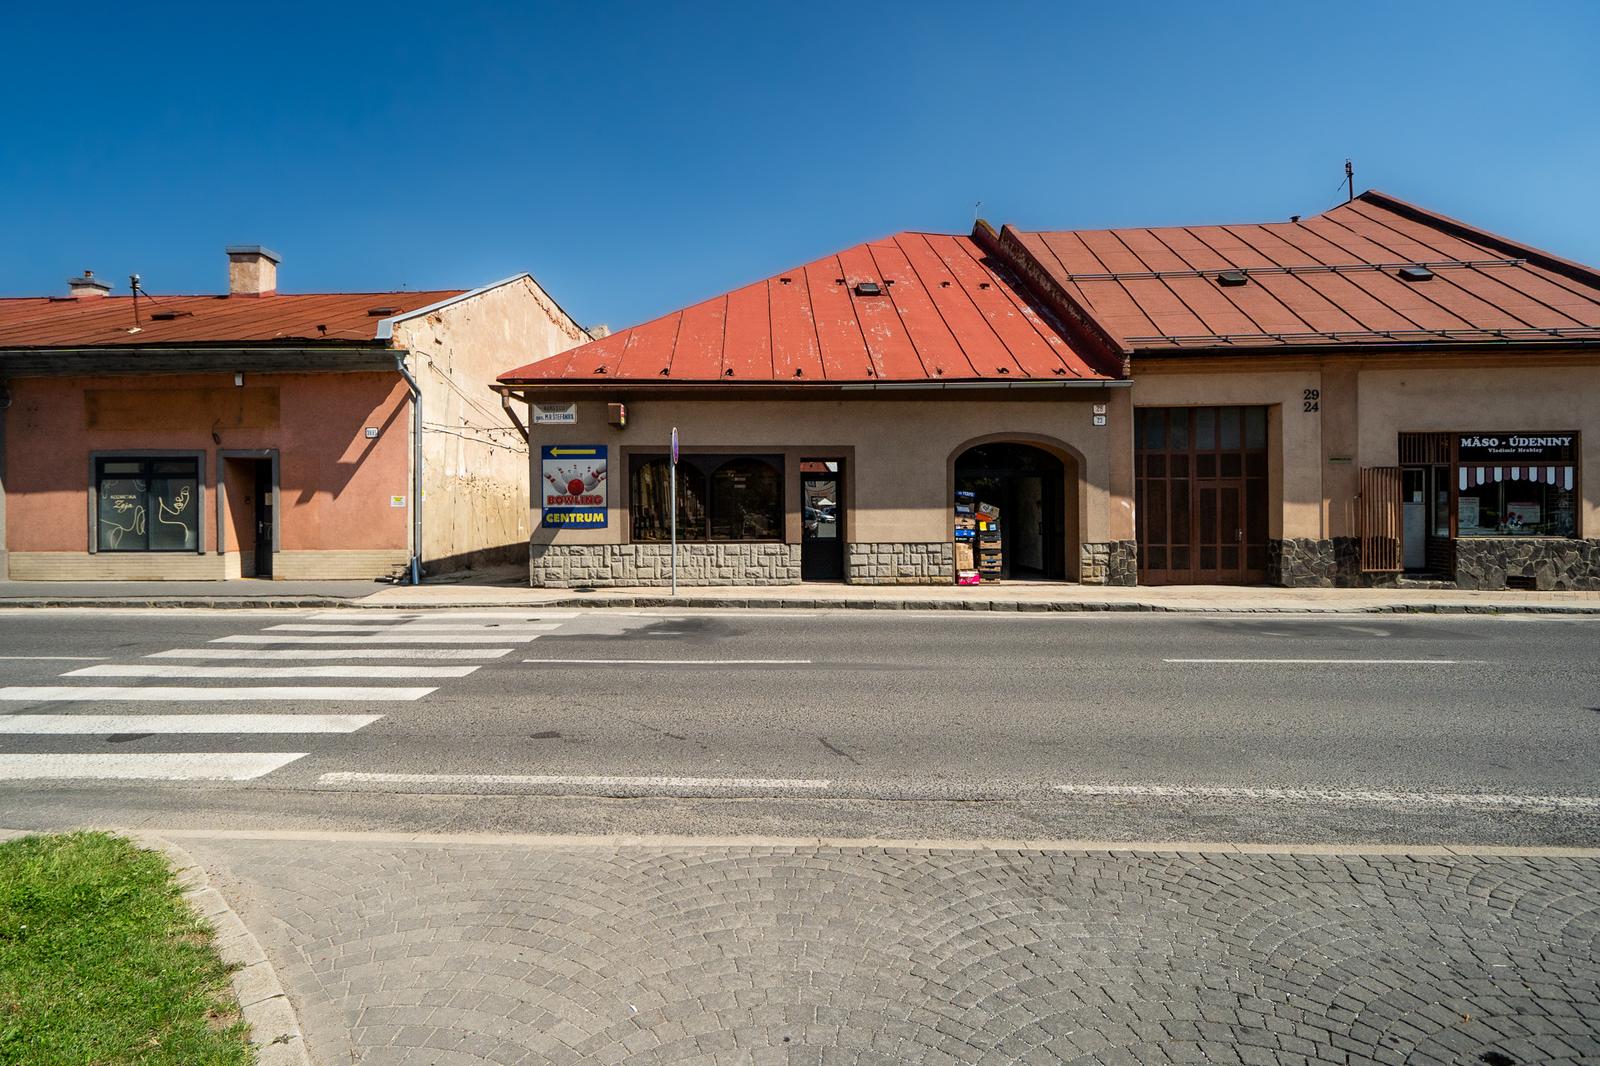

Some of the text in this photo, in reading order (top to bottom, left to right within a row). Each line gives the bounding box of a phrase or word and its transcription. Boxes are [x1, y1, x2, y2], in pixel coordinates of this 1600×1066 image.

[1304, 389, 1320, 400] 29
[1304, 401, 1320, 412] 24
[1461, 436, 1499, 447] MÄSO
[1509, 435, 1572, 447] ÚDENINY
[547, 495, 604, 506] BOWLING
[546, 513, 604, 523] CENTRUM
